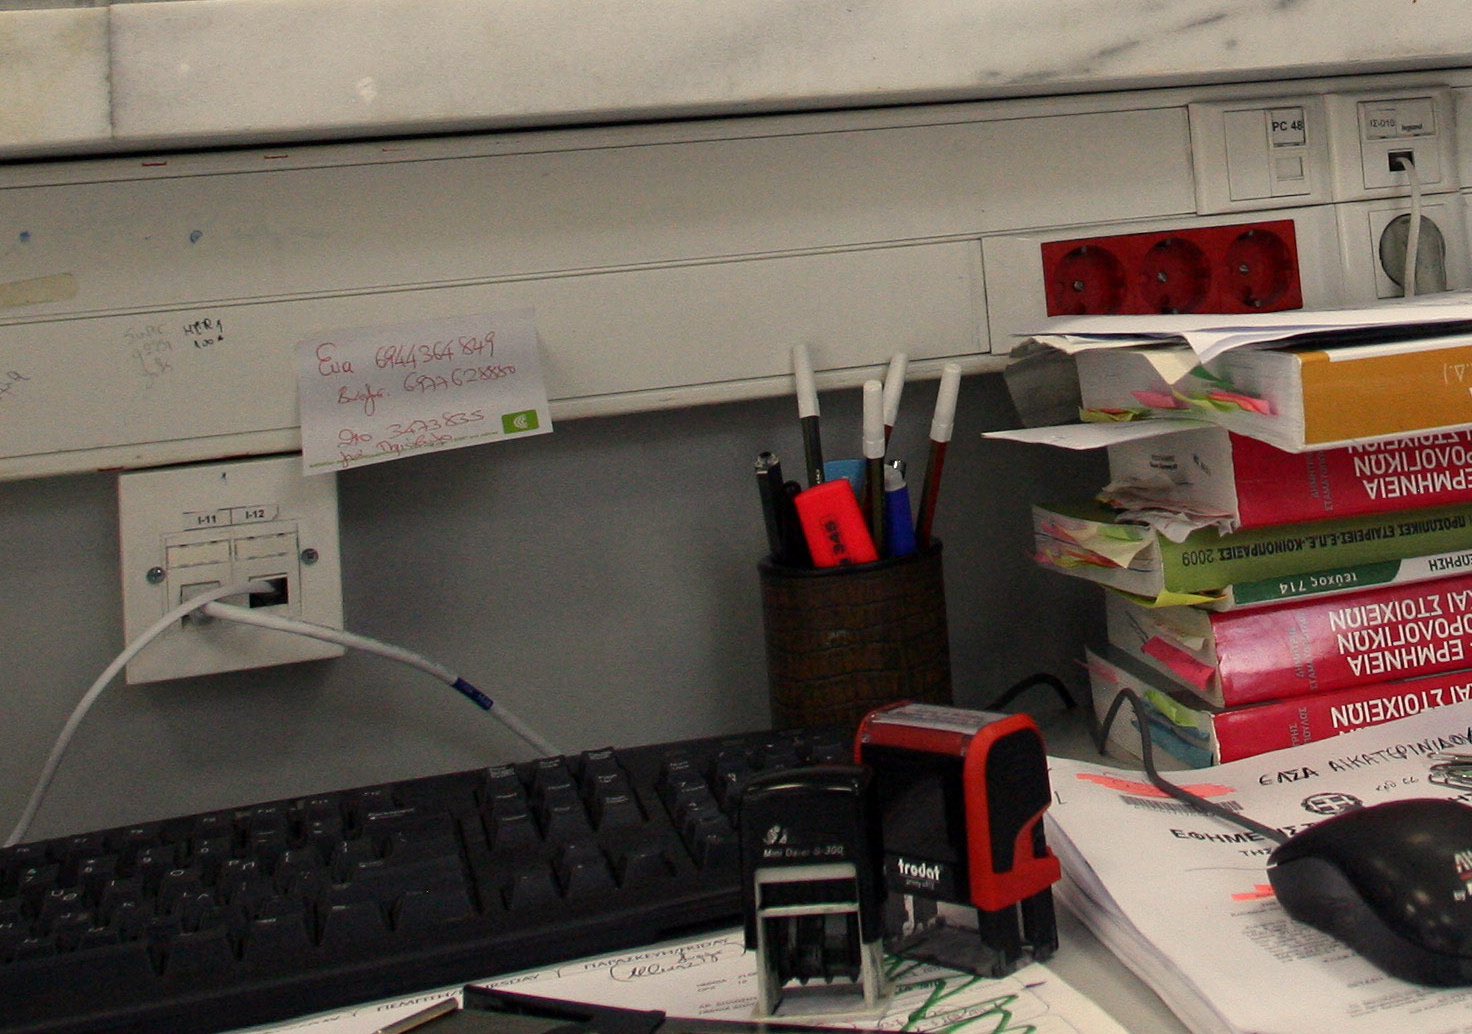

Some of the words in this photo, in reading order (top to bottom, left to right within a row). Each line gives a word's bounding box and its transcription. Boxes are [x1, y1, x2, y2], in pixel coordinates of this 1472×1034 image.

[1272, 121, 1288, 133] PC
[1290, 119, 1304, 132] 48
[245, 509, 265, 520] I-12
[1399, 516, 1466, 537] ΠΡΟΣΩΠΙΚΕΣ
[1182, 548, 1214, 567] 2009
[1279, 580, 1307, 595] 714
[1311, 572, 1358, 590] τεύχος
[1329, 595, 1443, 632] ΣΤΟΙΧΕΙΩΝ
[1347, 638, 1464, 677] ΕΡΜΗΝΕΙΑ
[1329, 688, 1444, 729] ΣΤΟΙΧΕΙΩΝ
[1259, 767, 1319, 786] ΕΛΣΑ
[898, 858, 941, 881] trodat
